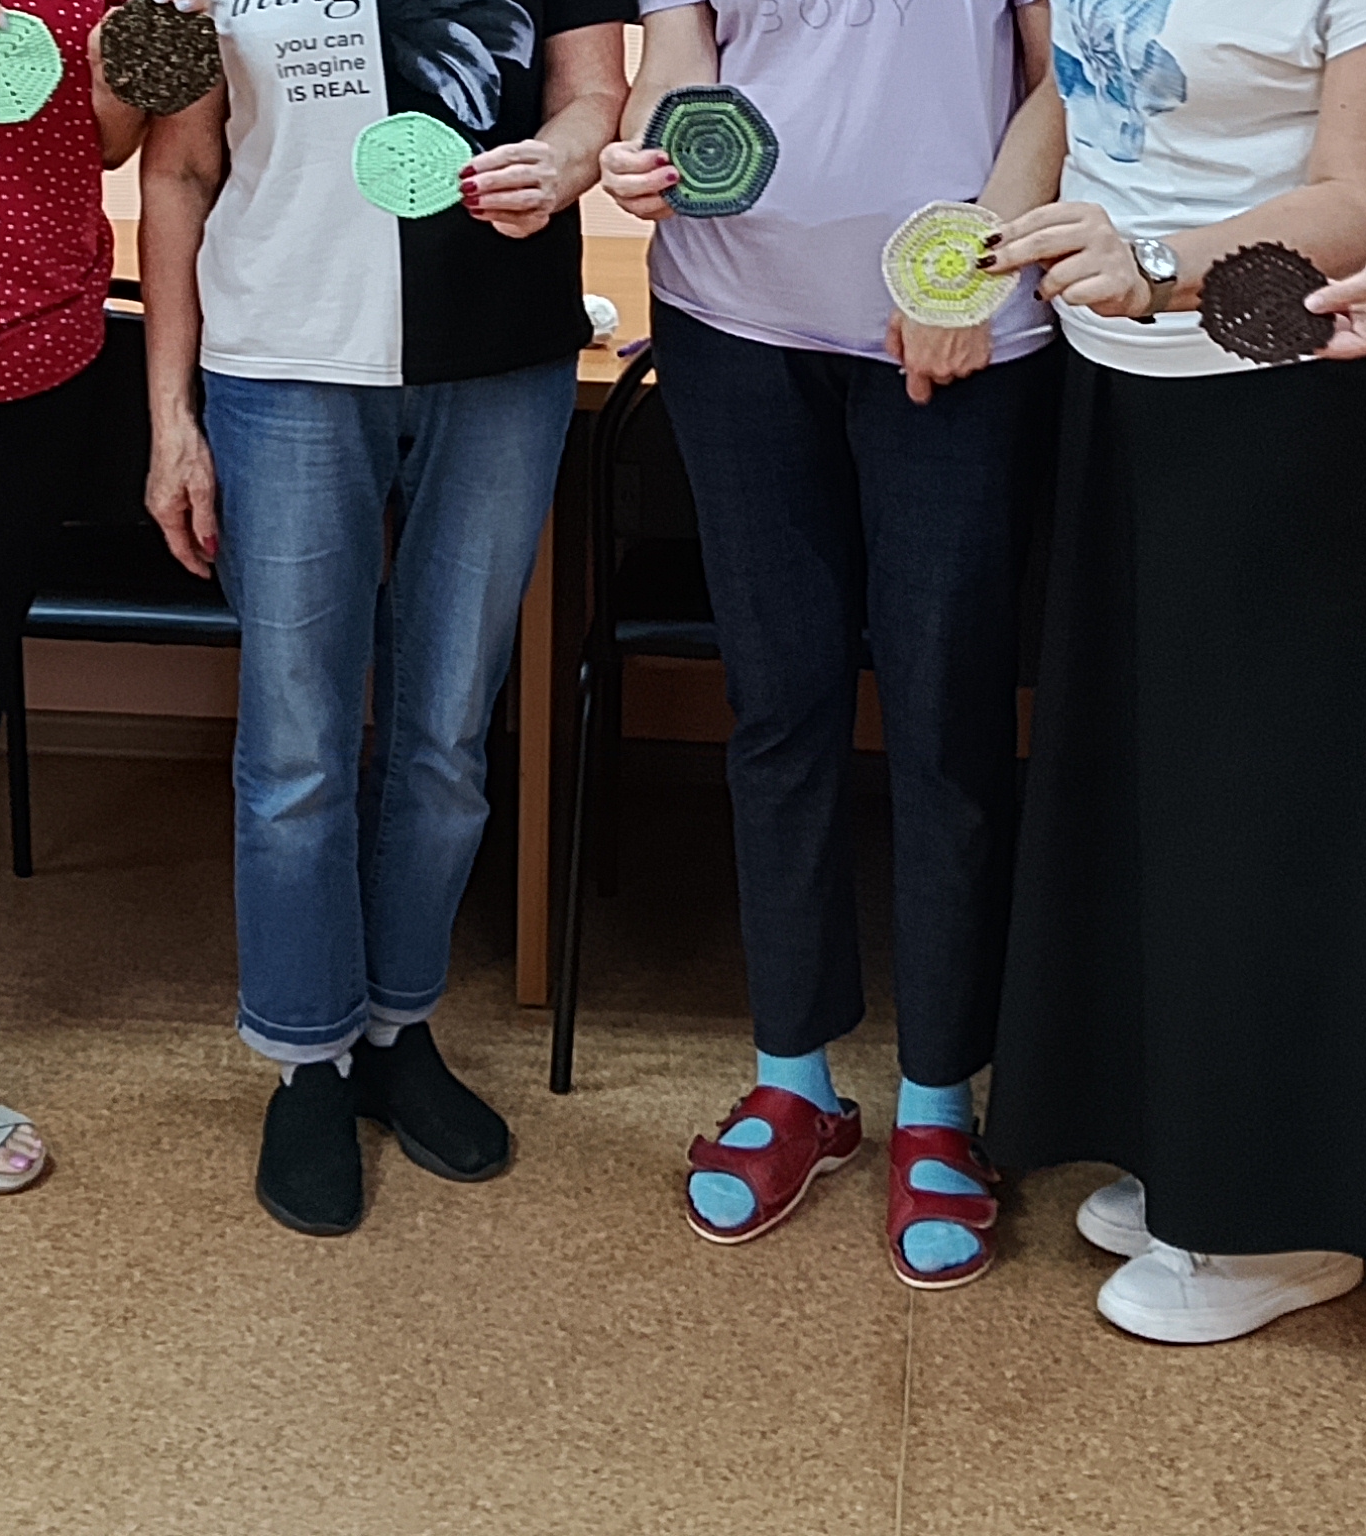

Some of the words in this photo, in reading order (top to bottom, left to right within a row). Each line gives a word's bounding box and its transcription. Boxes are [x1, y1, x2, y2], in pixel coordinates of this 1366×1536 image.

[275, 35, 317, 58] you
[323, 32, 366, 50] can
[277, 53, 367, 81] imagine
[287, 86, 308, 103] IS
[312, 79, 371, 100] REAL
